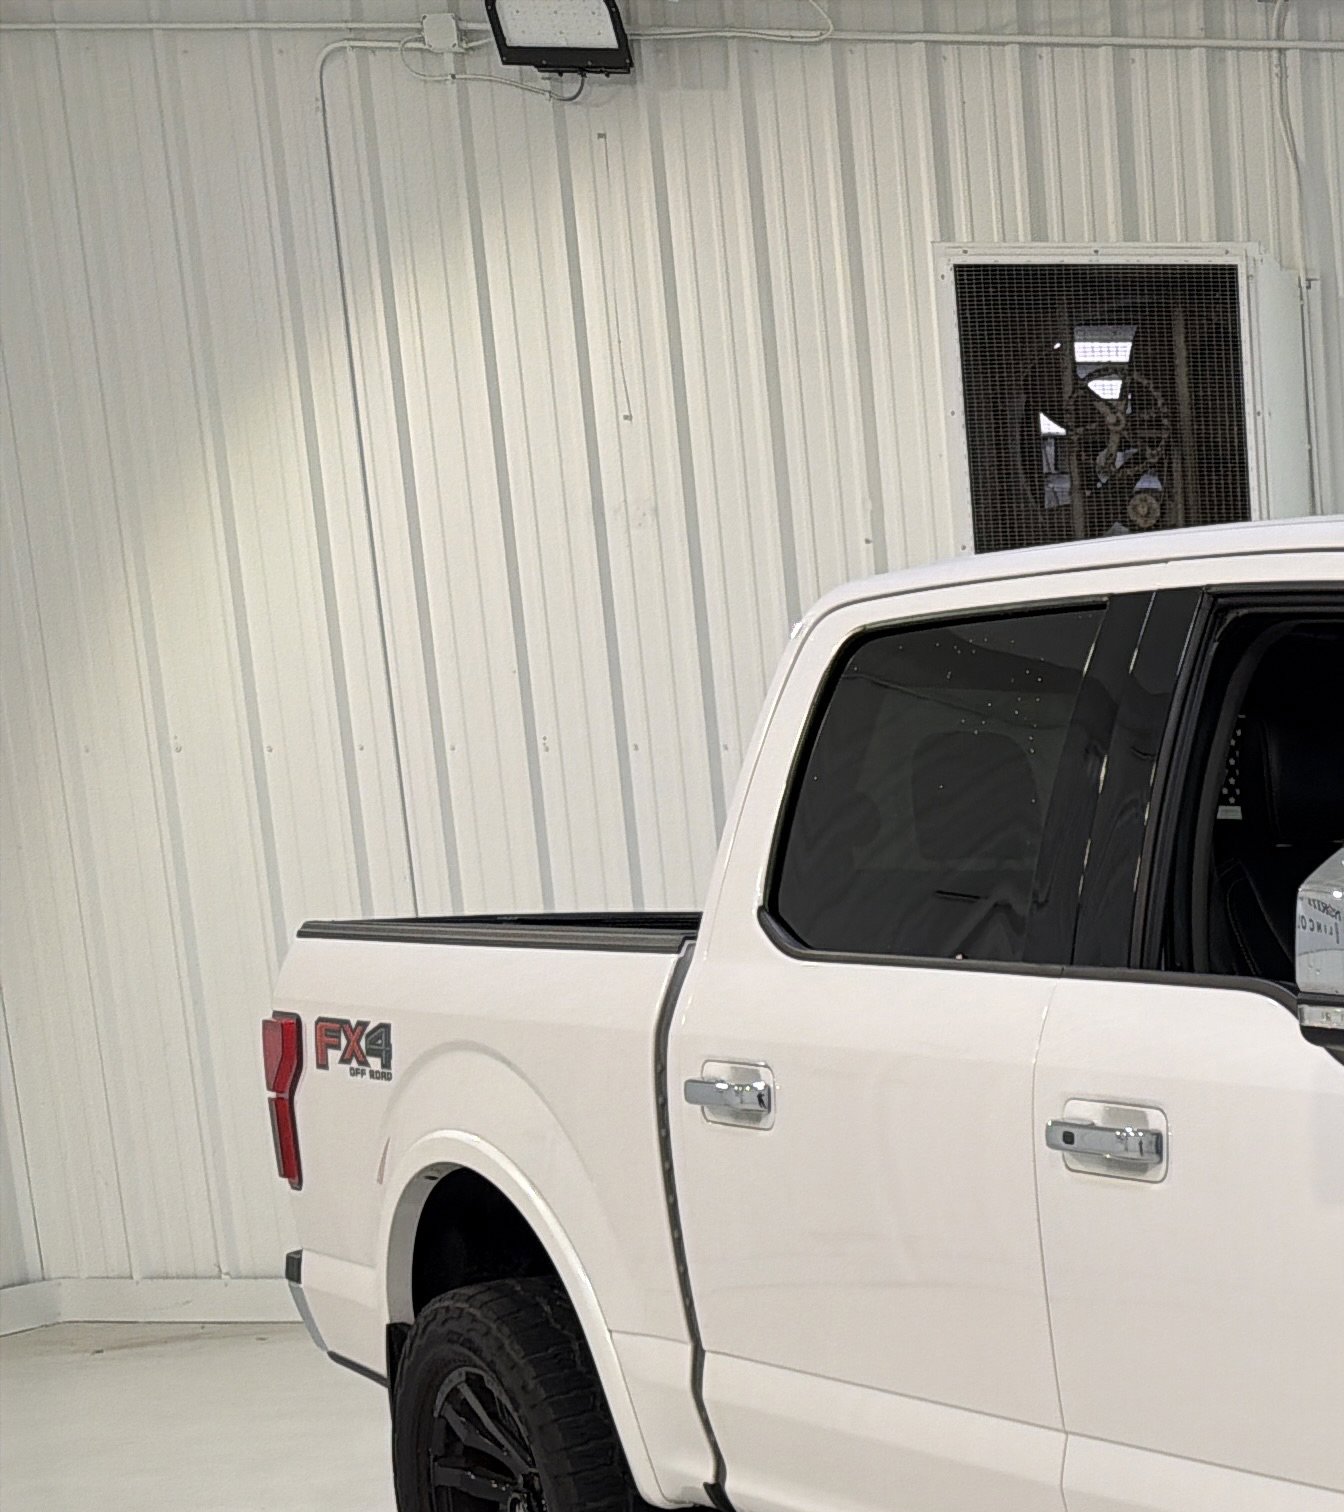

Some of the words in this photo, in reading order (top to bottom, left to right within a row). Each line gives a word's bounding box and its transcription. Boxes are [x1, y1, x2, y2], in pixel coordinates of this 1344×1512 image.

[314, 1016, 393, 1071] FX4
[349, 1066, 367, 1078] OFF
[369, 1069, 393, 1082] ROAD
